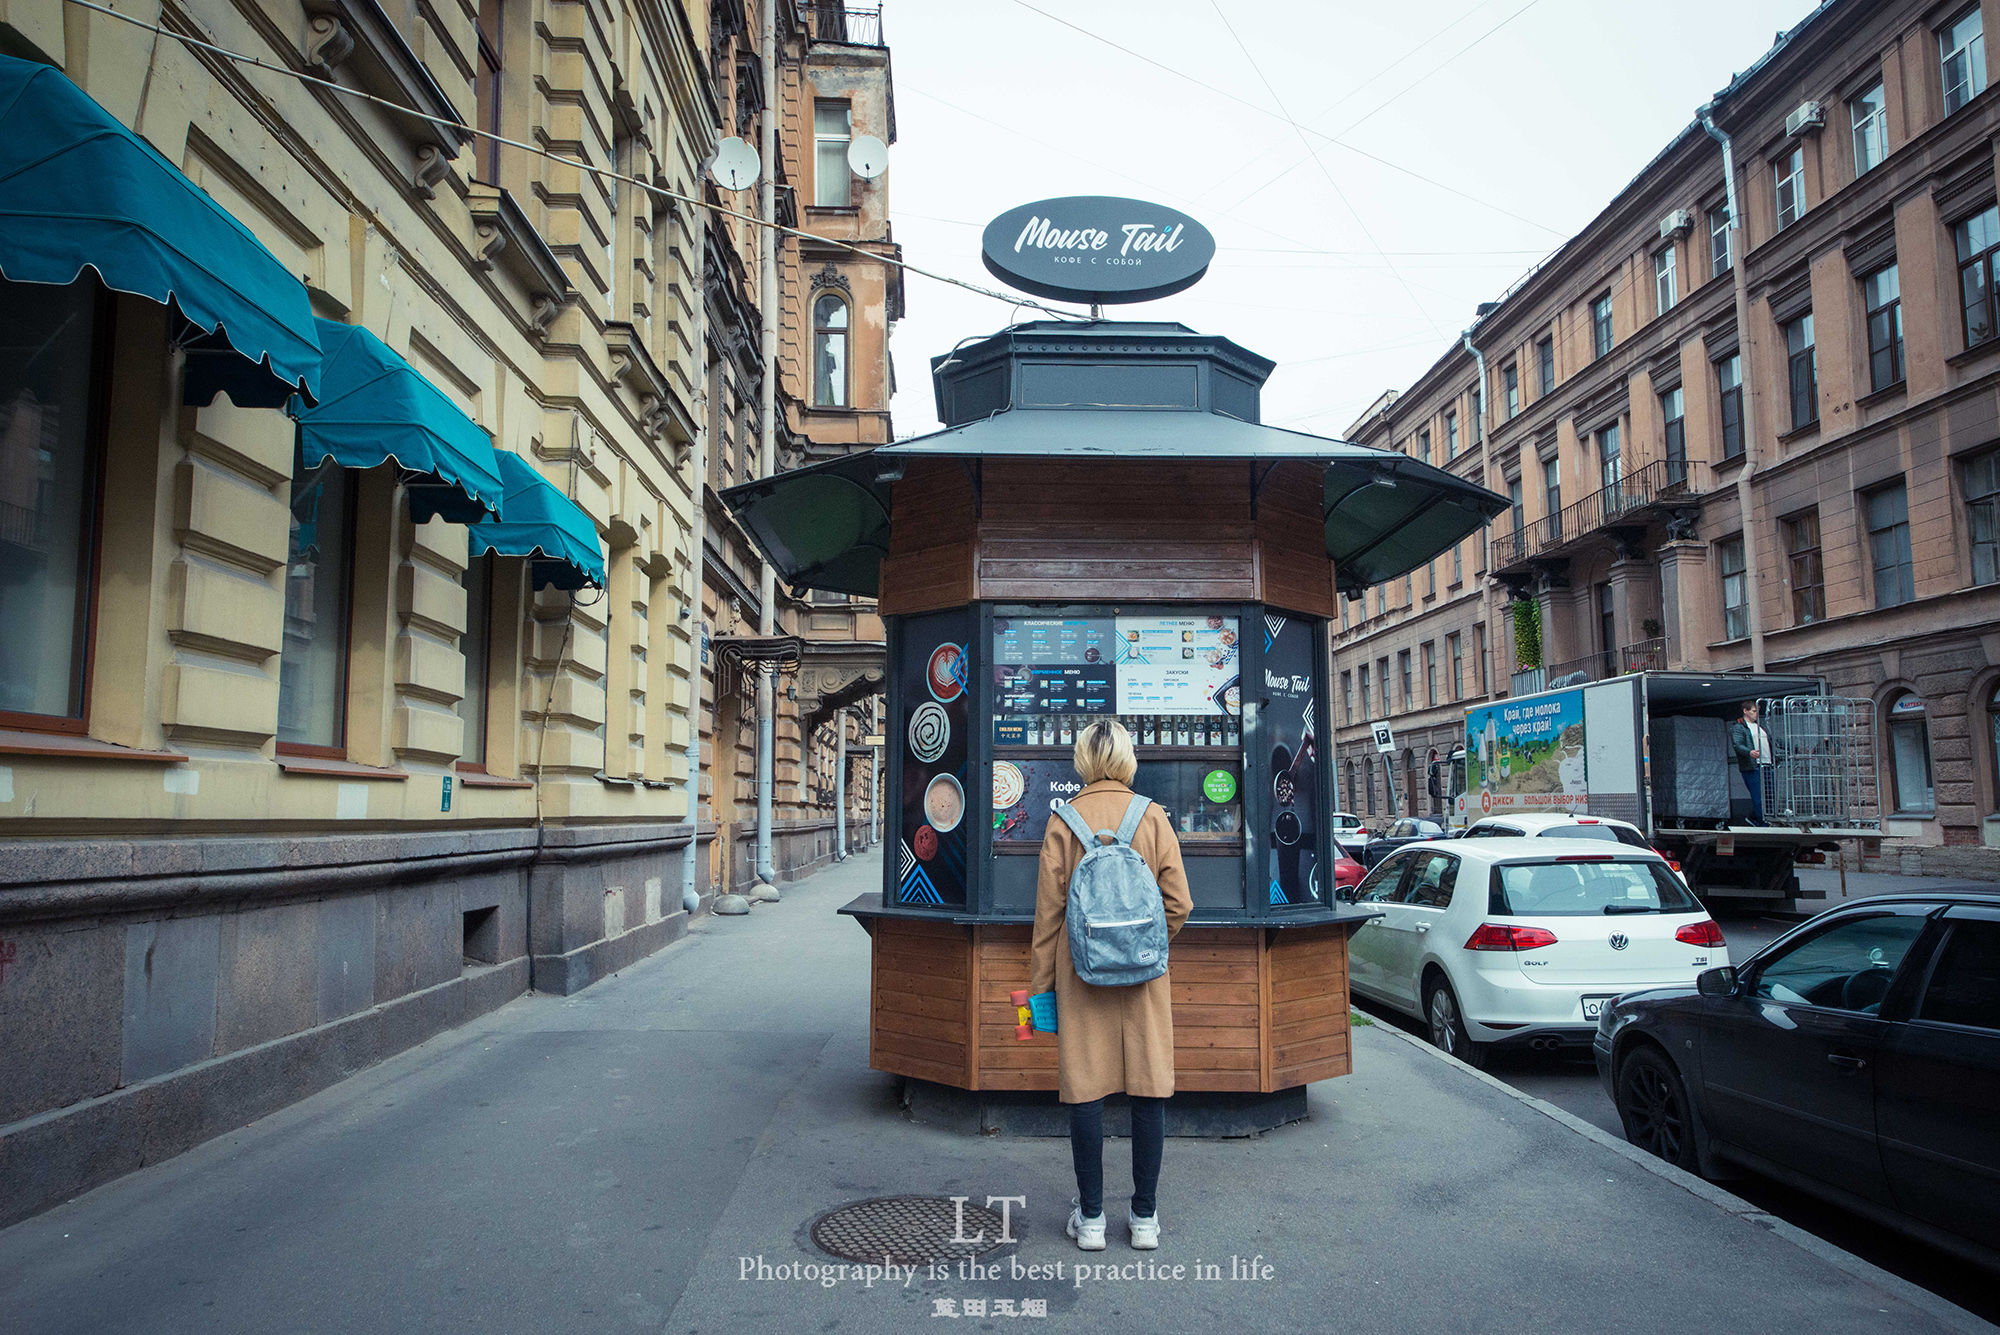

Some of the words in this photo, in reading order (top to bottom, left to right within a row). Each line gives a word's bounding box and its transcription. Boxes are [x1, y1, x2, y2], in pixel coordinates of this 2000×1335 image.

[1014, 215, 1109, 254] Mouse
[1120, 222, 1184, 257] Tail
[1054, 256, 1082, 265] КОФЕ
[1091, 257, 1097, 265] С
[1106, 257, 1142, 266] СОБОЙ
[1291, 675, 1311, 694] Tail
[1504, 706, 1520, 722] Край,
[1522, 706, 1534, 719] где
[1535, 702, 1560, 716] молока
[1512, 723, 1531, 736] через
[1533, 717, 1552, 735] край!
[1050, 781, 1081, 794] Кофе
[1492, 795, 1514, 806] ДИКСИ
[1524, 793, 1552, 805] БОЛЬШОЙ
[1553, 794, 1574, 805] ВЫБОР
